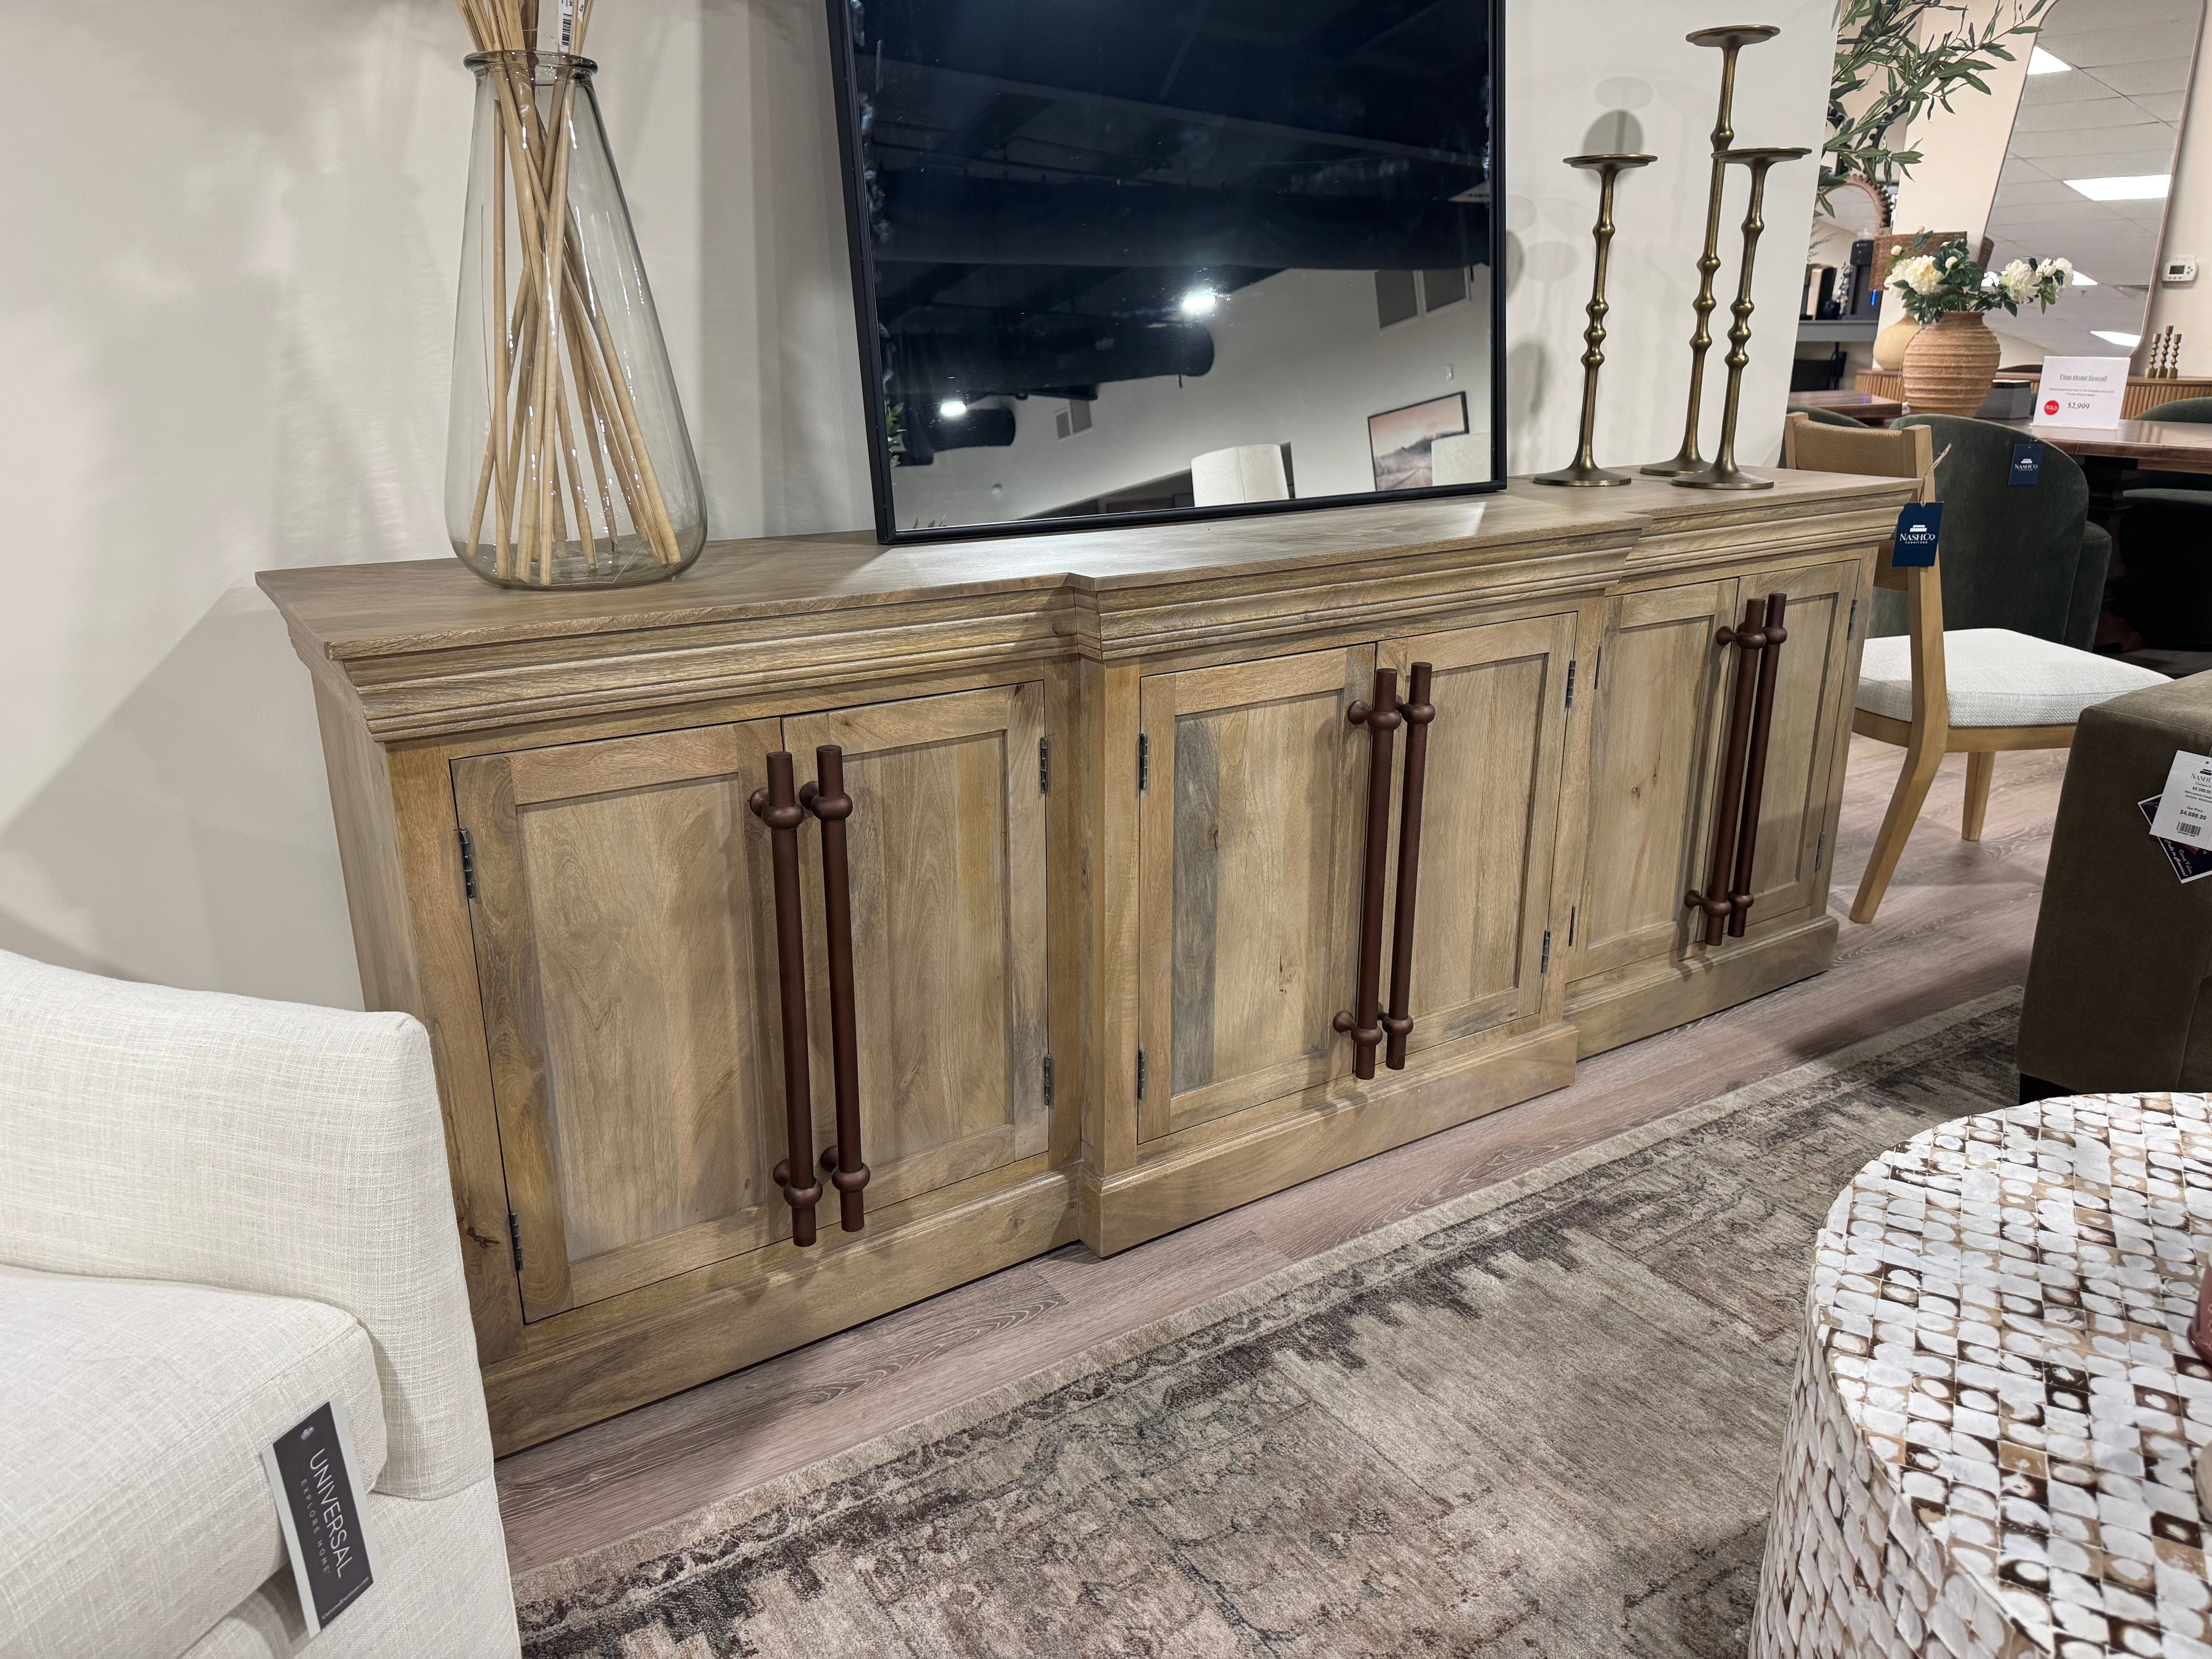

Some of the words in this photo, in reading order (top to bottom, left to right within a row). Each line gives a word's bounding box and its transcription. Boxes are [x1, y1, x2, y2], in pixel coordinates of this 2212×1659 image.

[2067, 401, 2090, 410] $2,999
[301, 1479, 320, 1534] EXPLORE
[310, 1448, 352, 1578] UNIVERSAL
